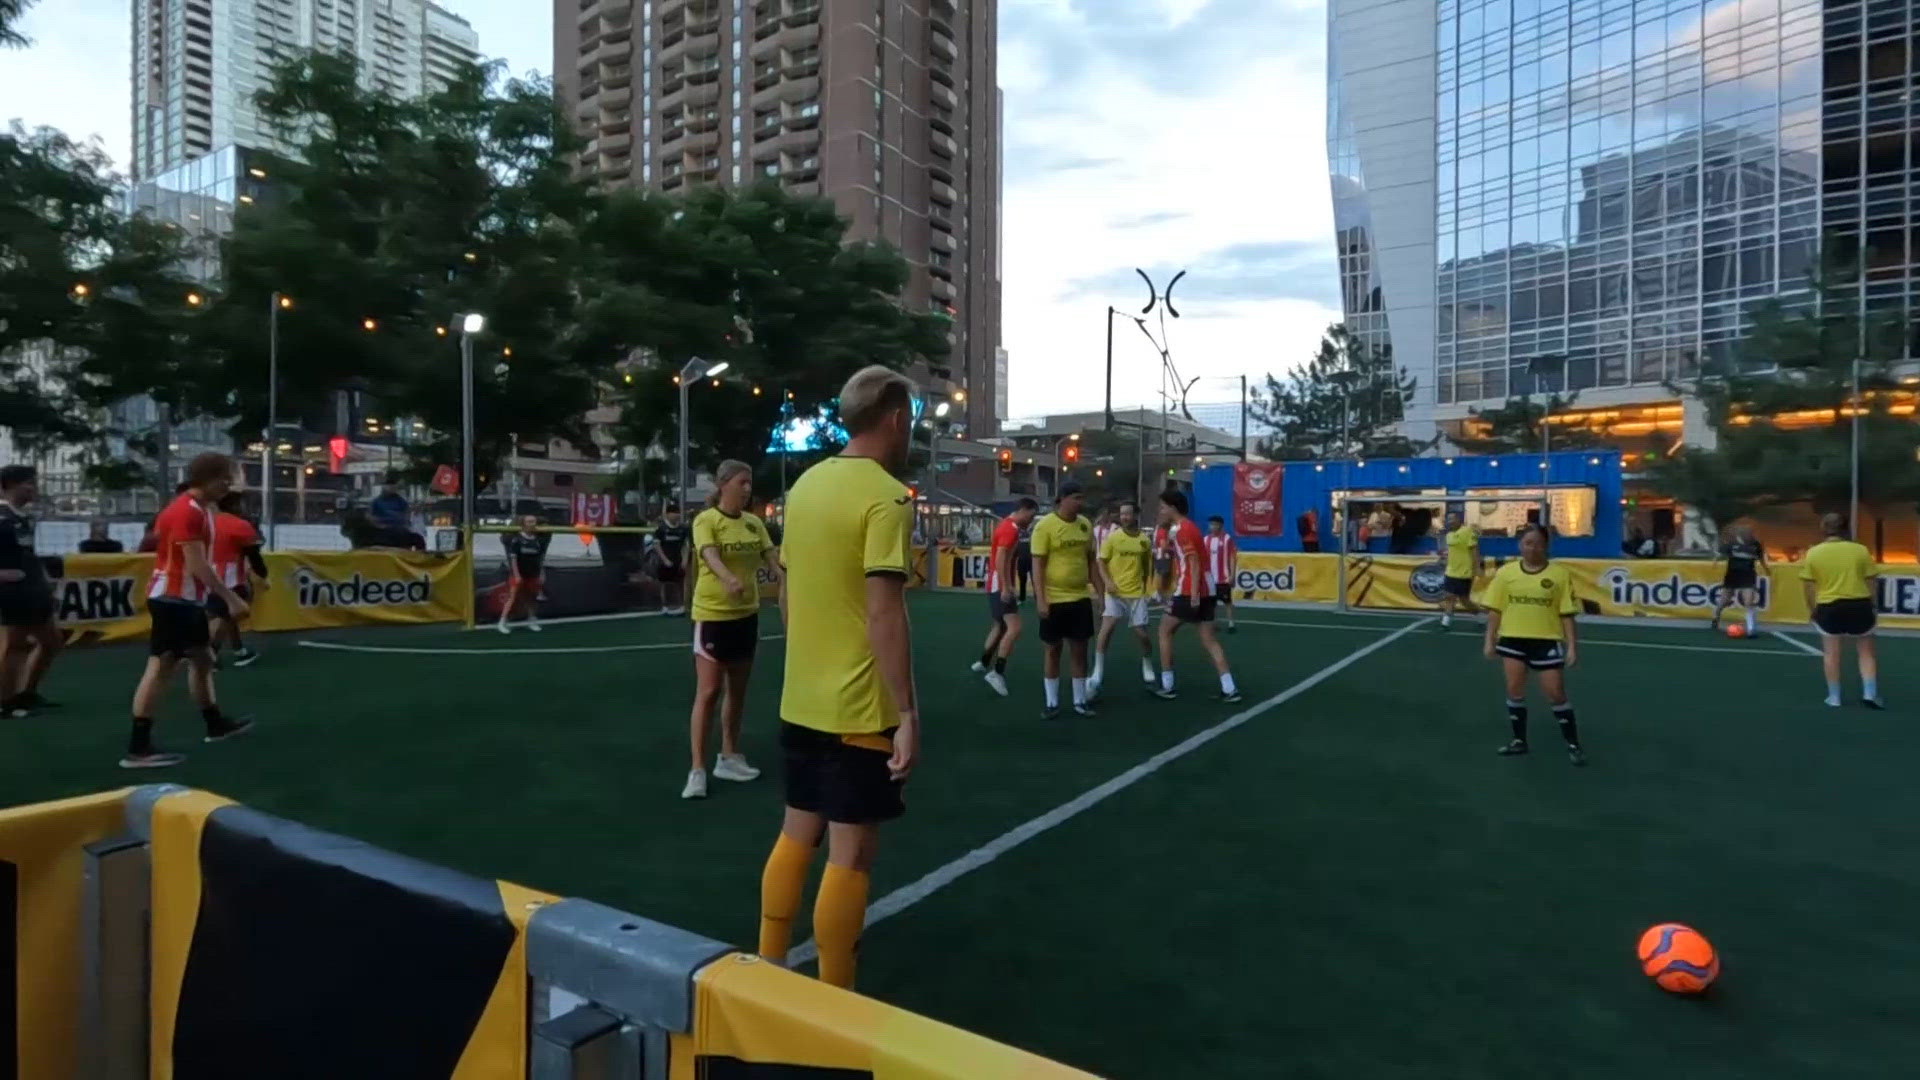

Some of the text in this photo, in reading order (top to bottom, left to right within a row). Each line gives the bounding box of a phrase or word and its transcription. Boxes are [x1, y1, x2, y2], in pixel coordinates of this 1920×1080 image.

[298, 569, 431, 606] indeed
[1237, 565, 1294, 590] eed
[1876, 577, 1920, 614] LE
[58, 577, 135, 620] ARK
